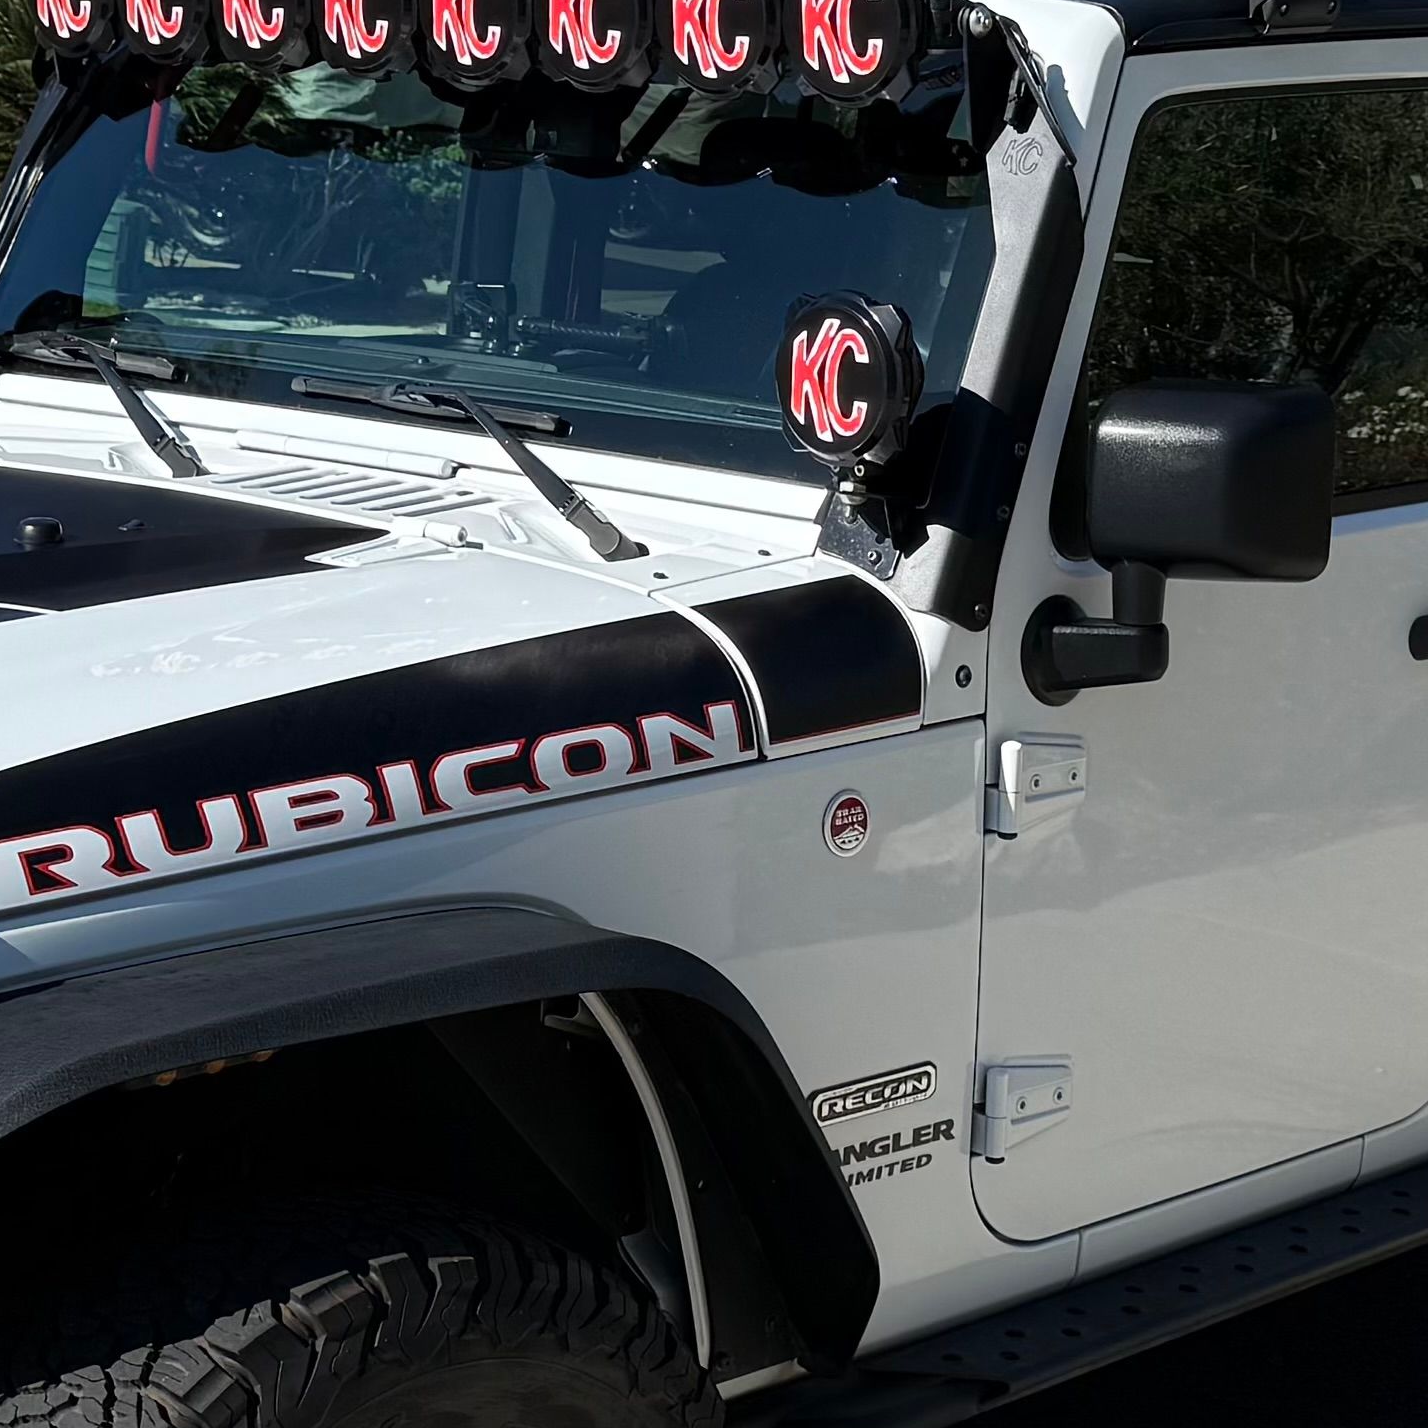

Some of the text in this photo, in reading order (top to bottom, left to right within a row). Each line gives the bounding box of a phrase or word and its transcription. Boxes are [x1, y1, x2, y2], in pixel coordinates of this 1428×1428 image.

[1001, 137, 1043, 176] KC
[790, 317, 868, 442] KC
[821, 1075, 928, 1118] RECON
[830, 1118, 955, 1166] ANGLER
[847, 1153, 933, 1187] IMITED
